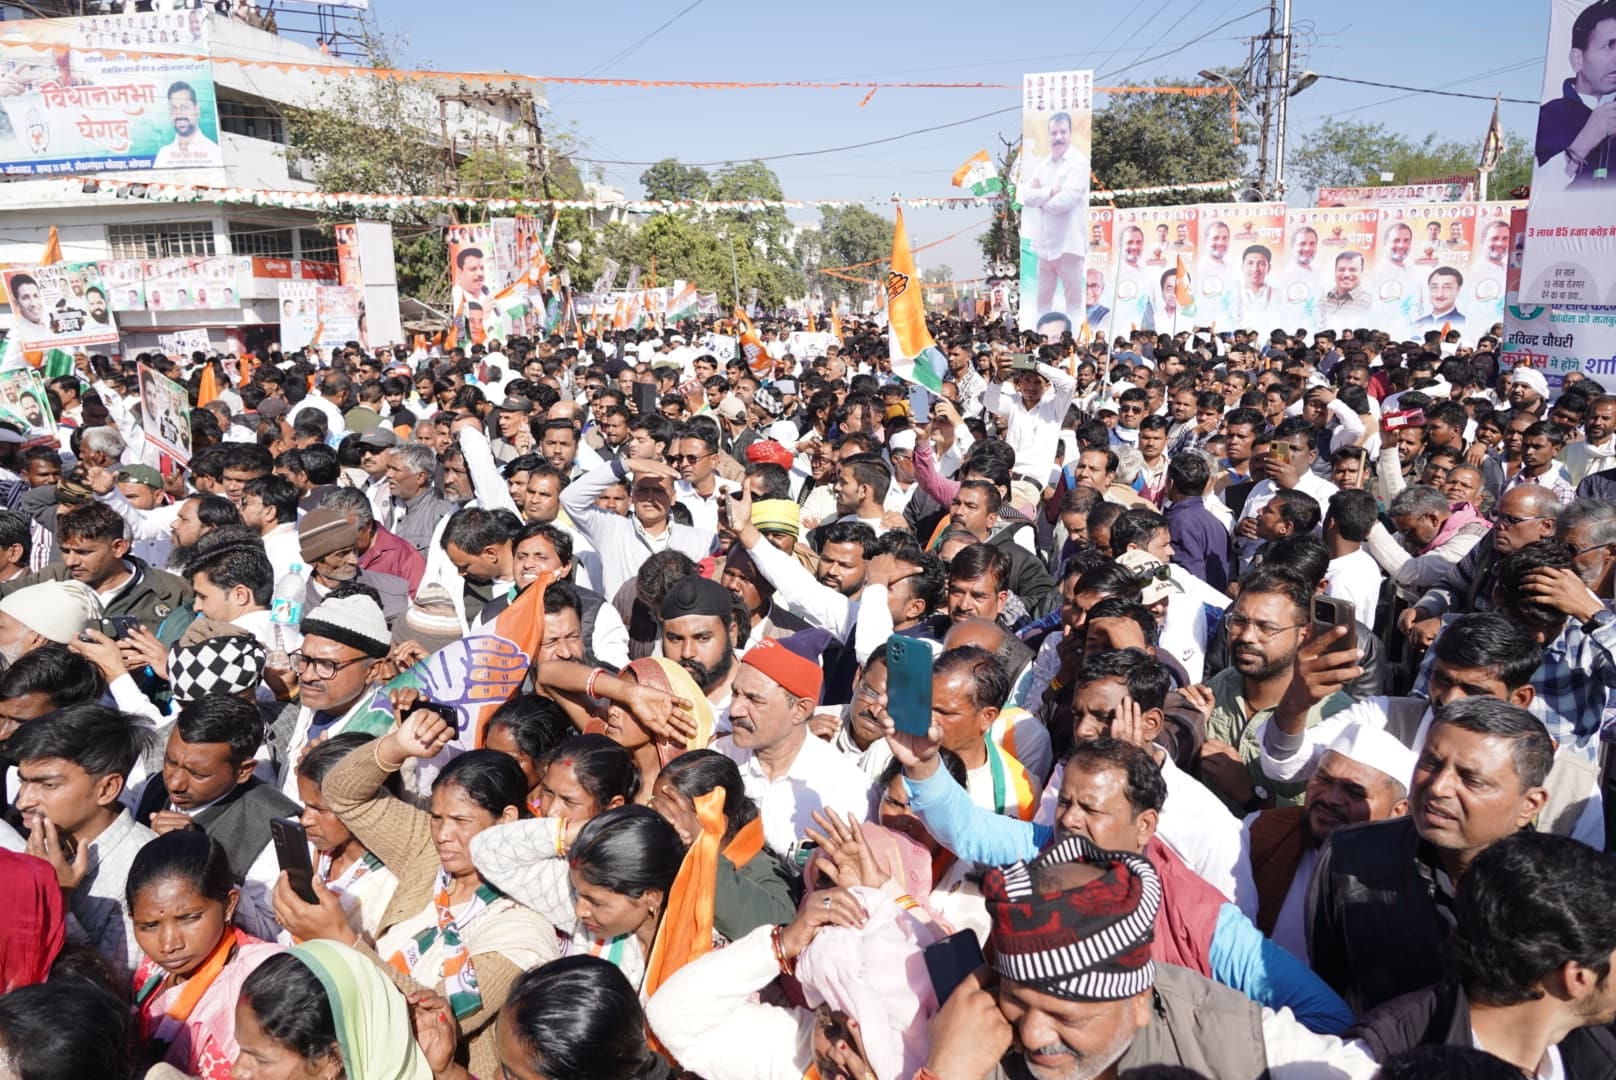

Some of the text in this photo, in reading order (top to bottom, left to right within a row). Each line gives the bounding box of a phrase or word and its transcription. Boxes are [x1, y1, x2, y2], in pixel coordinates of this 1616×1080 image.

[40, 81, 156, 115] विधानसभा
[1528, 228, 1535, 238] 3
[1536, 229, 1554, 238] लाख
[1555, 227, 1568, 237] 85
[1570, 228, 1588, 237] हजार
[1508, 331, 1574, 348] रविन्द्र चौधरी
